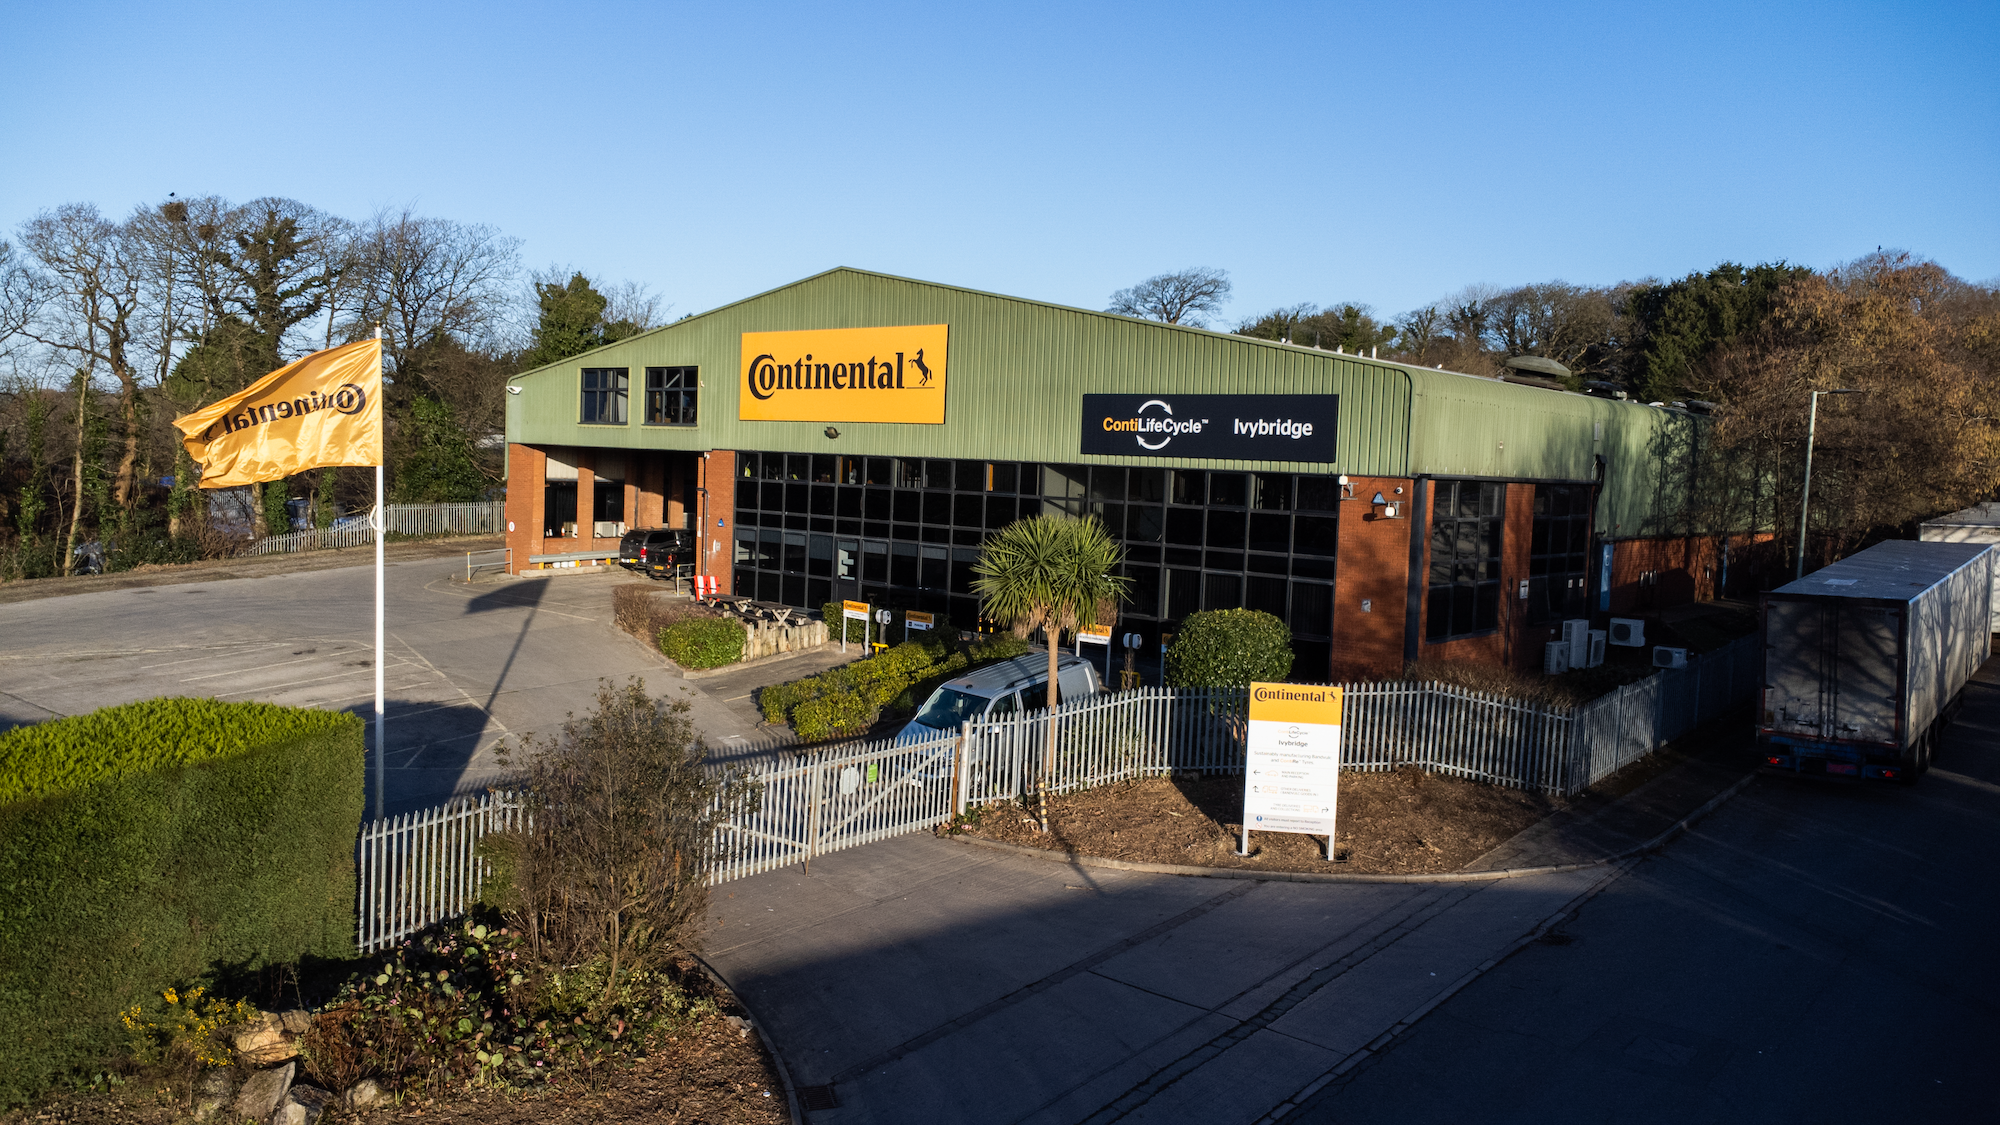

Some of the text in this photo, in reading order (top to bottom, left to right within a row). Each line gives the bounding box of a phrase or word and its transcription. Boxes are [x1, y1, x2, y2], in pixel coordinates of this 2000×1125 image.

[748, 352, 905, 400] Continental
[1233, 418, 1313, 439] Ivybridge
[1254, 687, 1326, 702] Continental
[1278, 740, 1309, 748] Ivybridge
